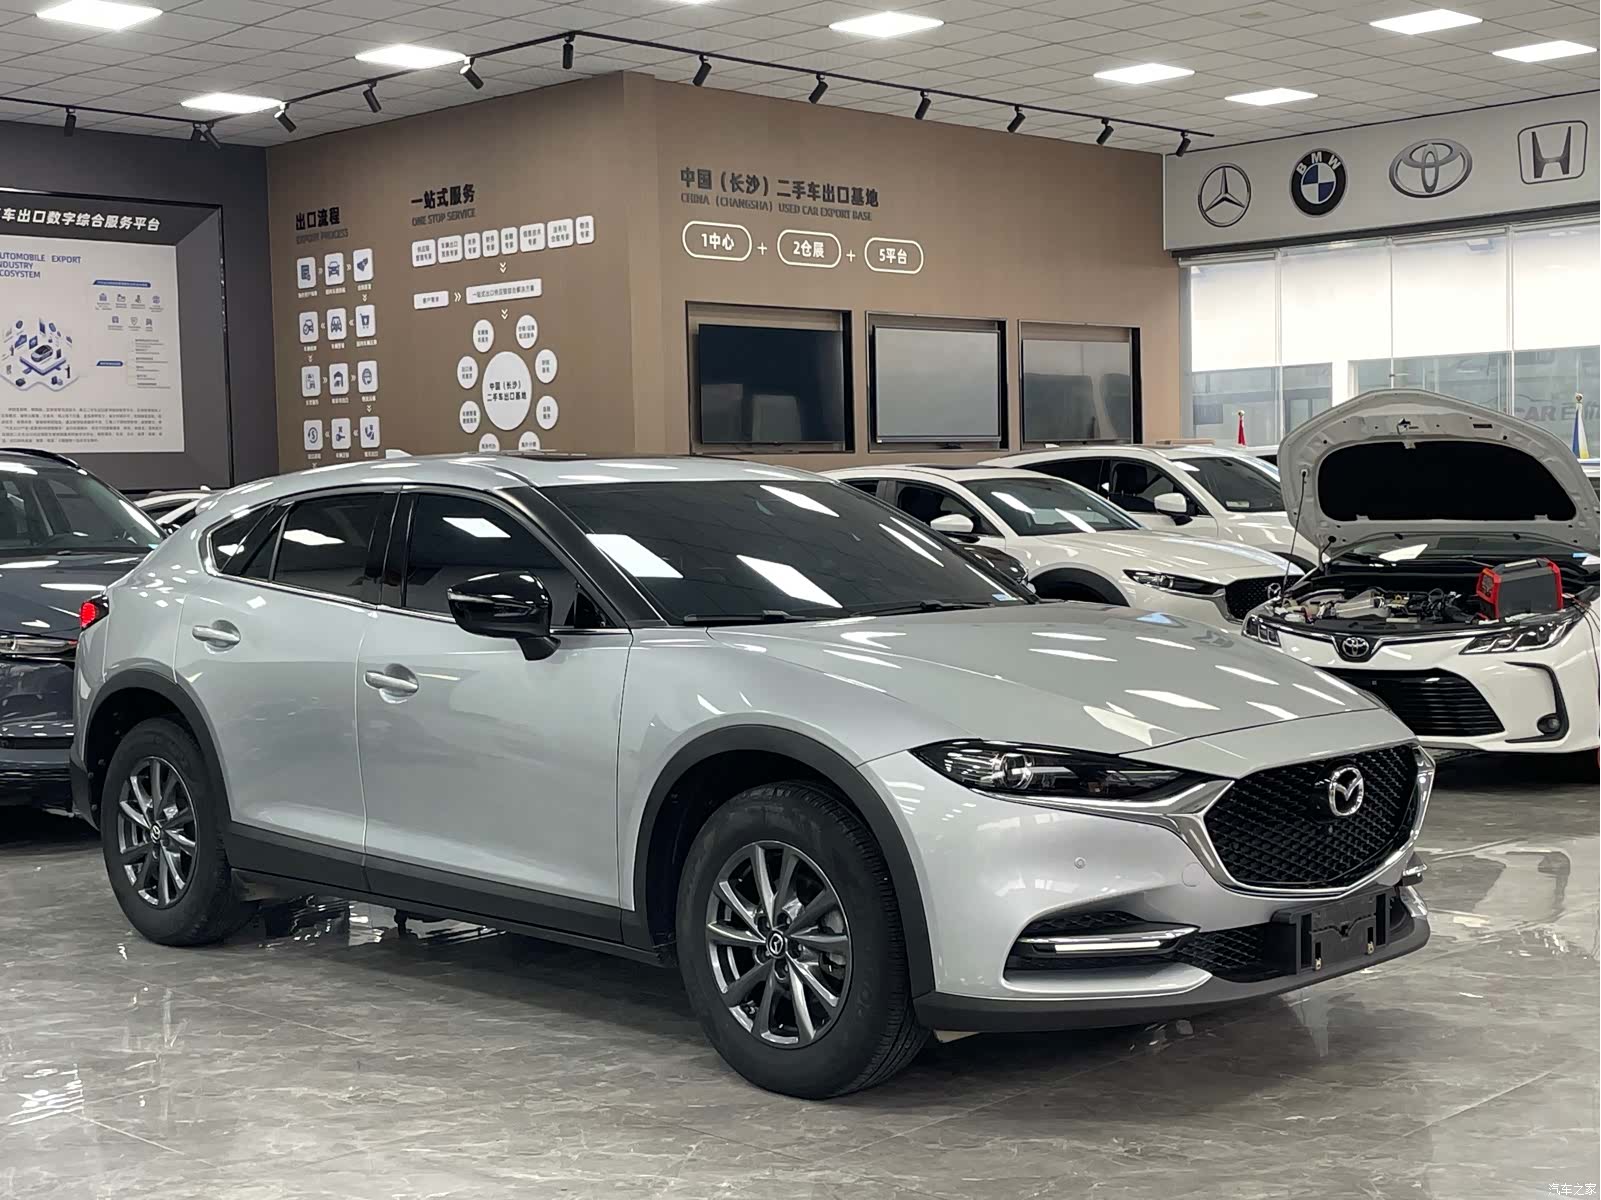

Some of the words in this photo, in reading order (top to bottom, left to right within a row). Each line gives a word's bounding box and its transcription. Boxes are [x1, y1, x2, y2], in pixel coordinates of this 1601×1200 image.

[1296, 151, 1341, 175] BMW
[410, 184, 476, 209] 一站式服务
[680, 167, 879, 208] 中国（长沙）二手车出口基地
[411, 215, 427, 226] ONE
[428, 212, 446, 225] STOP
[447, 208, 476, 222] SERVICE
[681, 192, 710, 206] CHINA
[778, 202, 800, 214] USED
[802, 204, 819, 217] CAR
[820, 206, 850, 220] EXPORT
[852, 210, 872, 221] BASE
[0, 207, 161, 231] 车出口数字综合服务平台
[295, 207, 340, 231] 出口流程
[0, 252, 46, 262] UTOMOBILE
[51, 255, 81, 264] EXPORT
[701, 232, 735, 251] 1中心
[879, 248, 908, 265] 5平台
[486, 391, 527, 402] 二手车出口基地
